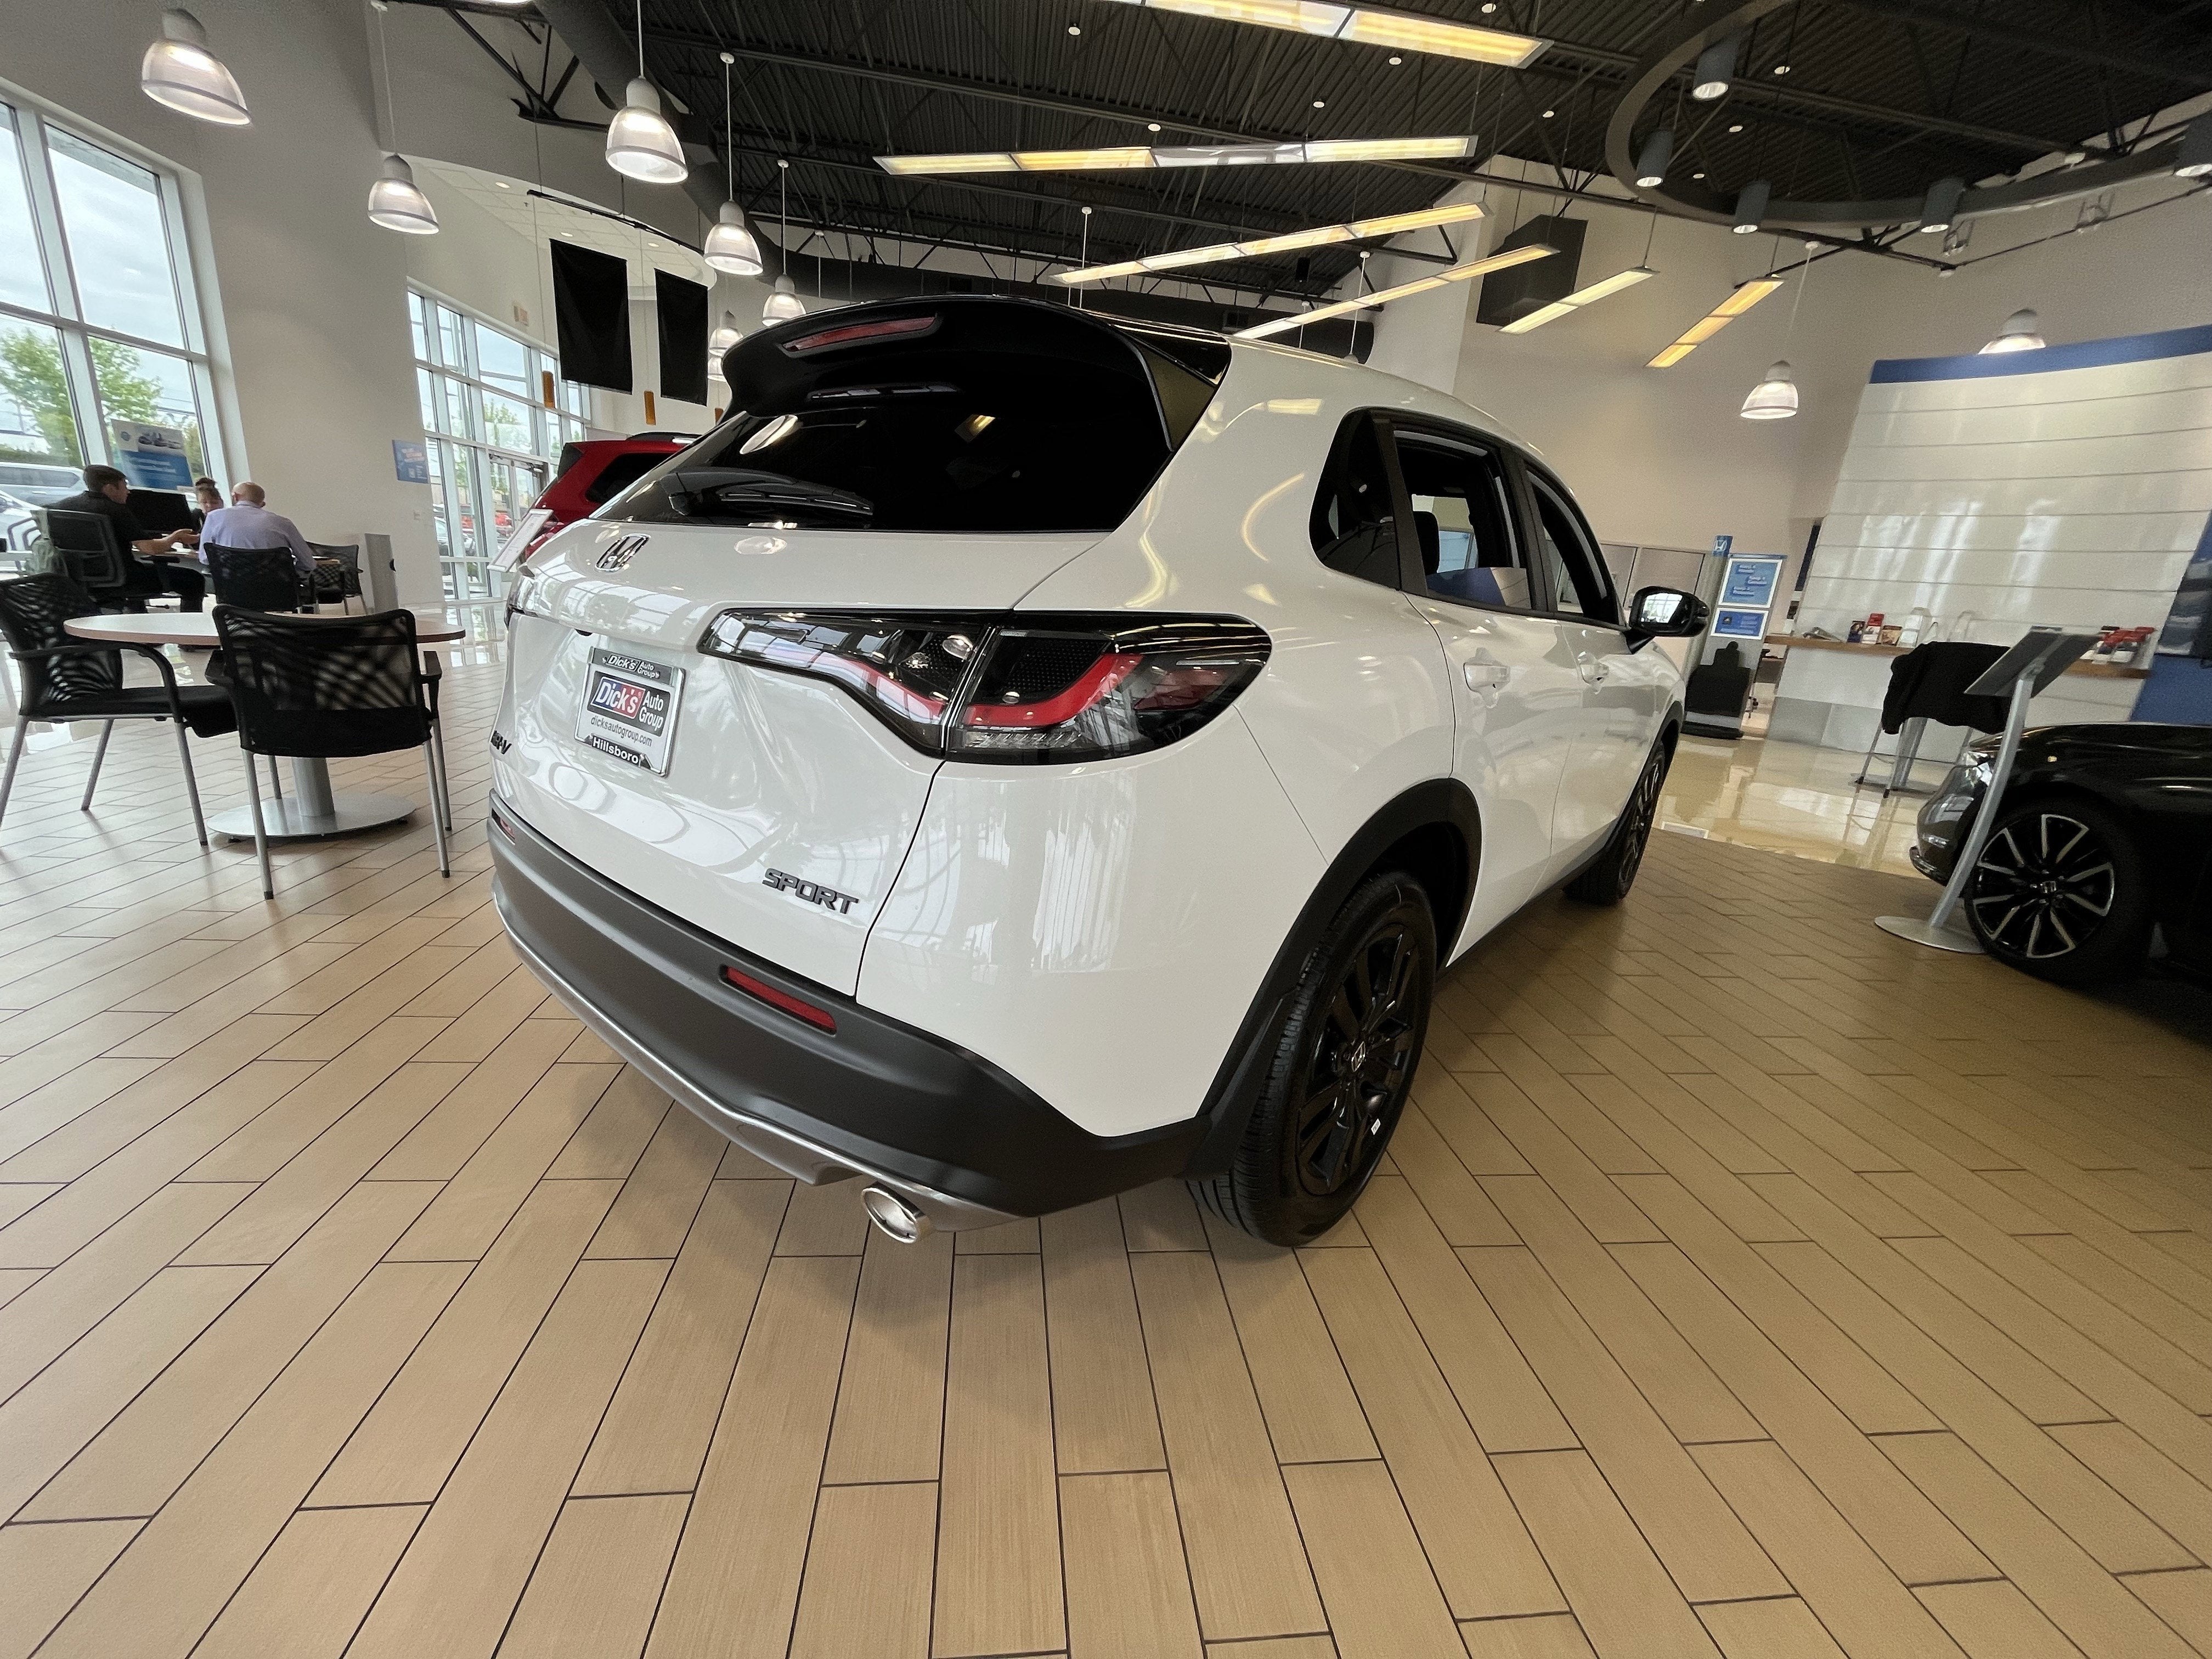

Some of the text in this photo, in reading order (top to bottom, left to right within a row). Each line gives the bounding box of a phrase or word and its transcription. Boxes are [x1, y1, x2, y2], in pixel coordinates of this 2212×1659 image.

[608, 655, 636, 670] Dick's
[637, 667, 656, 679] Group
[640, 662, 654, 671] Auto
[595, 681, 639, 713] Dick's
[642, 691, 664, 712] Auto
[590, 715, 652, 747] dicksautogroup.com
[639, 706, 664, 731] Group
[592, 737, 639, 764] Hillsboro
[761, 867, 860, 915] SPORT
